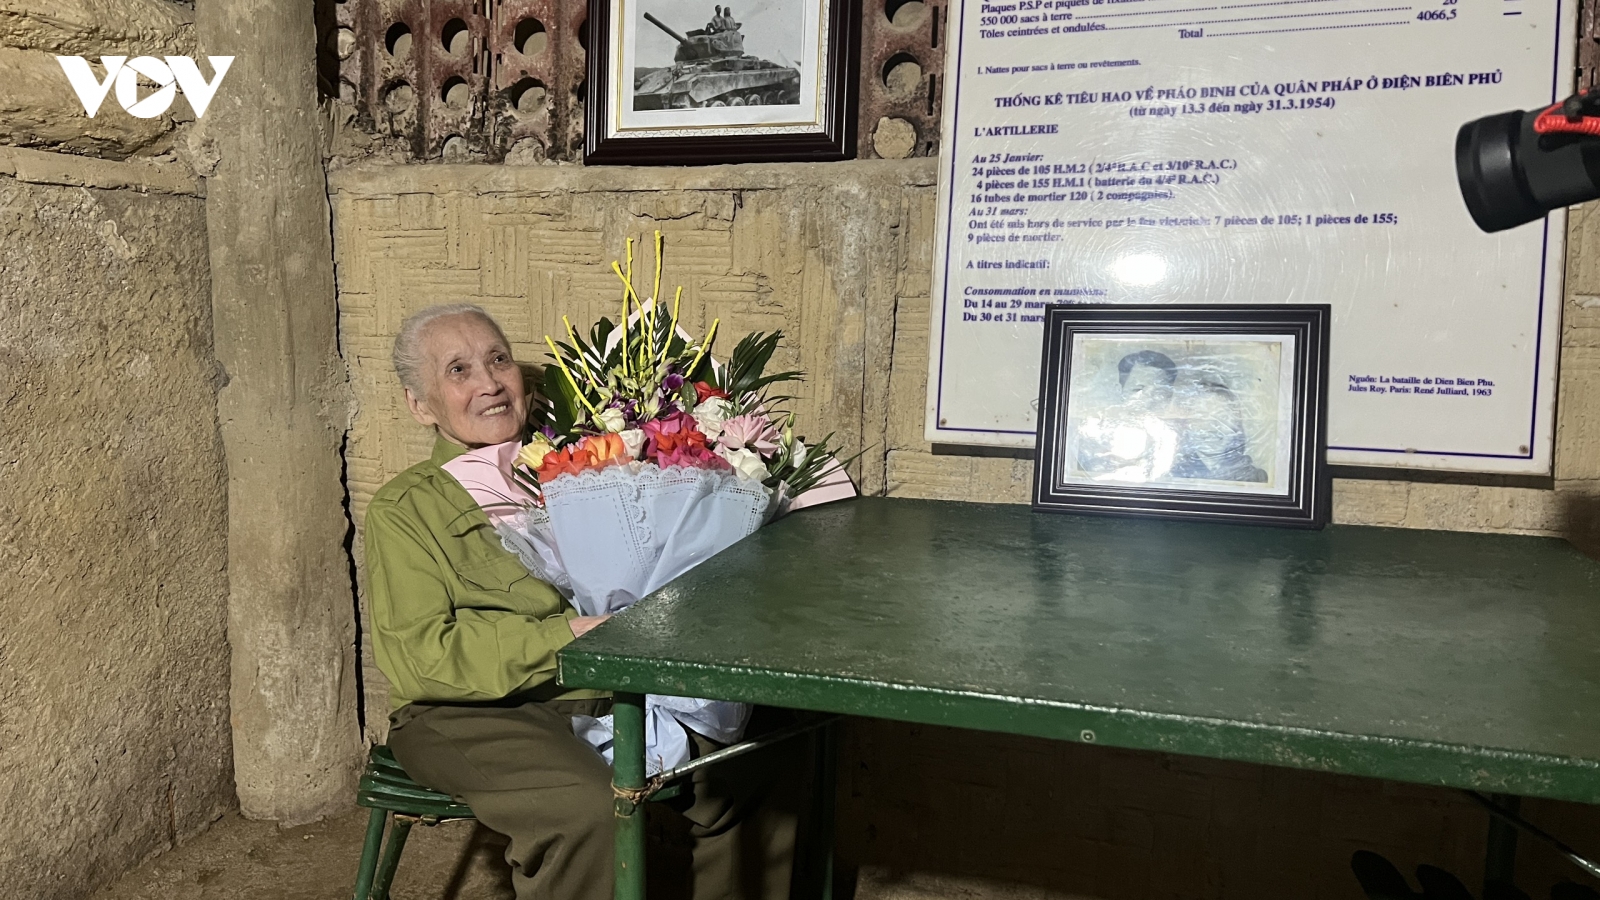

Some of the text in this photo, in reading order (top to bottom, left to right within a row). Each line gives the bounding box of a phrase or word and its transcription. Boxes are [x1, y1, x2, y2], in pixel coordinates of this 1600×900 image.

[981, 4, 1016, 14] Plaques
[980, 11, 1072, 26] 550 000 sacs à terre
[1178, 9, 1457, 39] Total 4066,5
[980, 29, 1004, 39] Tôles
[1007, 25, 1048, 36] ceintrées
[1051, 25, 1060, 33] et
[985, 66, 1009, 74] Nattes
[1012, 66, 1029, 75] pour
[1050, 62, 1055, 70] à
[1090, 59, 1141, 68] revêtements.
[995, 69, 1502, 108] THỐNG KÊ TIÊU HAO VỀ PHÁO BINH CỦA QUÂN PHÁP Ở ĐIỆN BIÊN PHỦ
[1129, 106, 1147, 118] (từ
[1149, 105, 1177, 117] ngày
[1208, 101, 1230, 113] đến
[1234, 100, 1263, 113] ngày
[1267, 97, 1336, 111] 31.3.1954)
[974, 124, 1058, 137] L'ARTILLERIE
[972, 153, 1044, 163] Au 25 Janvier:
[972, 167, 984, 176] 24
[986, 166, 1015, 178] pièces
[1018, 166, 1030, 175] de
[1033, 165, 1050, 175] 105
[1053, 164, 1086, 174] H.M.2
[977, 180, 983, 189] 4
[985, 179, 1015, 191] pièces
[1017, 179, 1029, 188] de
[1032, 179, 1049, 188] 155
[1053, 178, 1084, 187] H.M.1
[1095, 177, 1135, 186] batterie
[971, 194, 981, 203] 16
[984, 193, 1011, 203] tubes
[1013, 193, 1025, 202] de
[1028, 192, 1067, 202] mortier
[1070, 191, 1087, 200] 120
[969, 207, 1028, 217] Au 31 mars:
[969, 220, 987, 229] Ont
[990, 219, 1004, 228] été
[1007, 220, 1024, 228] mis
[1027, 219, 1049, 228] hors
[1052, 219, 1064, 227] de
[1067, 219, 1101, 227] service
[1215, 216, 1221, 225] 7
[1224, 216, 1258, 227] pièces
[1261, 215, 1274, 225] de
[1278, 215, 1302, 226] 105;
[1306, 215, 1311, 224] 1
[1315, 214, 1350, 227] pièces
[1354, 214, 1368, 224] de
[1372, 213, 1398, 225] 155;
[968, 232, 1064, 244] 9 pièces de mortier.
[966, 260, 1050, 269] A titres indicatif:
[964, 286, 1036, 296] Consommation
[964, 299, 978, 308] Du
[981, 299, 992, 308] 14
[1010, 299, 1021, 308] 29
[963, 312, 977, 321] Du
[980, 313, 992, 321] 30
[1006, 313, 1017, 321] 31
[1380, 376, 1390, 384] La
[1392, 376, 1421, 385] bataille
[1423, 377, 1433, 385] de
[1435, 377, 1454, 385] Dien
[1457, 378, 1475, 386] Bien
[1477, 379, 1495, 387] Phu.
[1414, 386, 1434, 394] René
[1473, 388, 1492, 396] 1963
